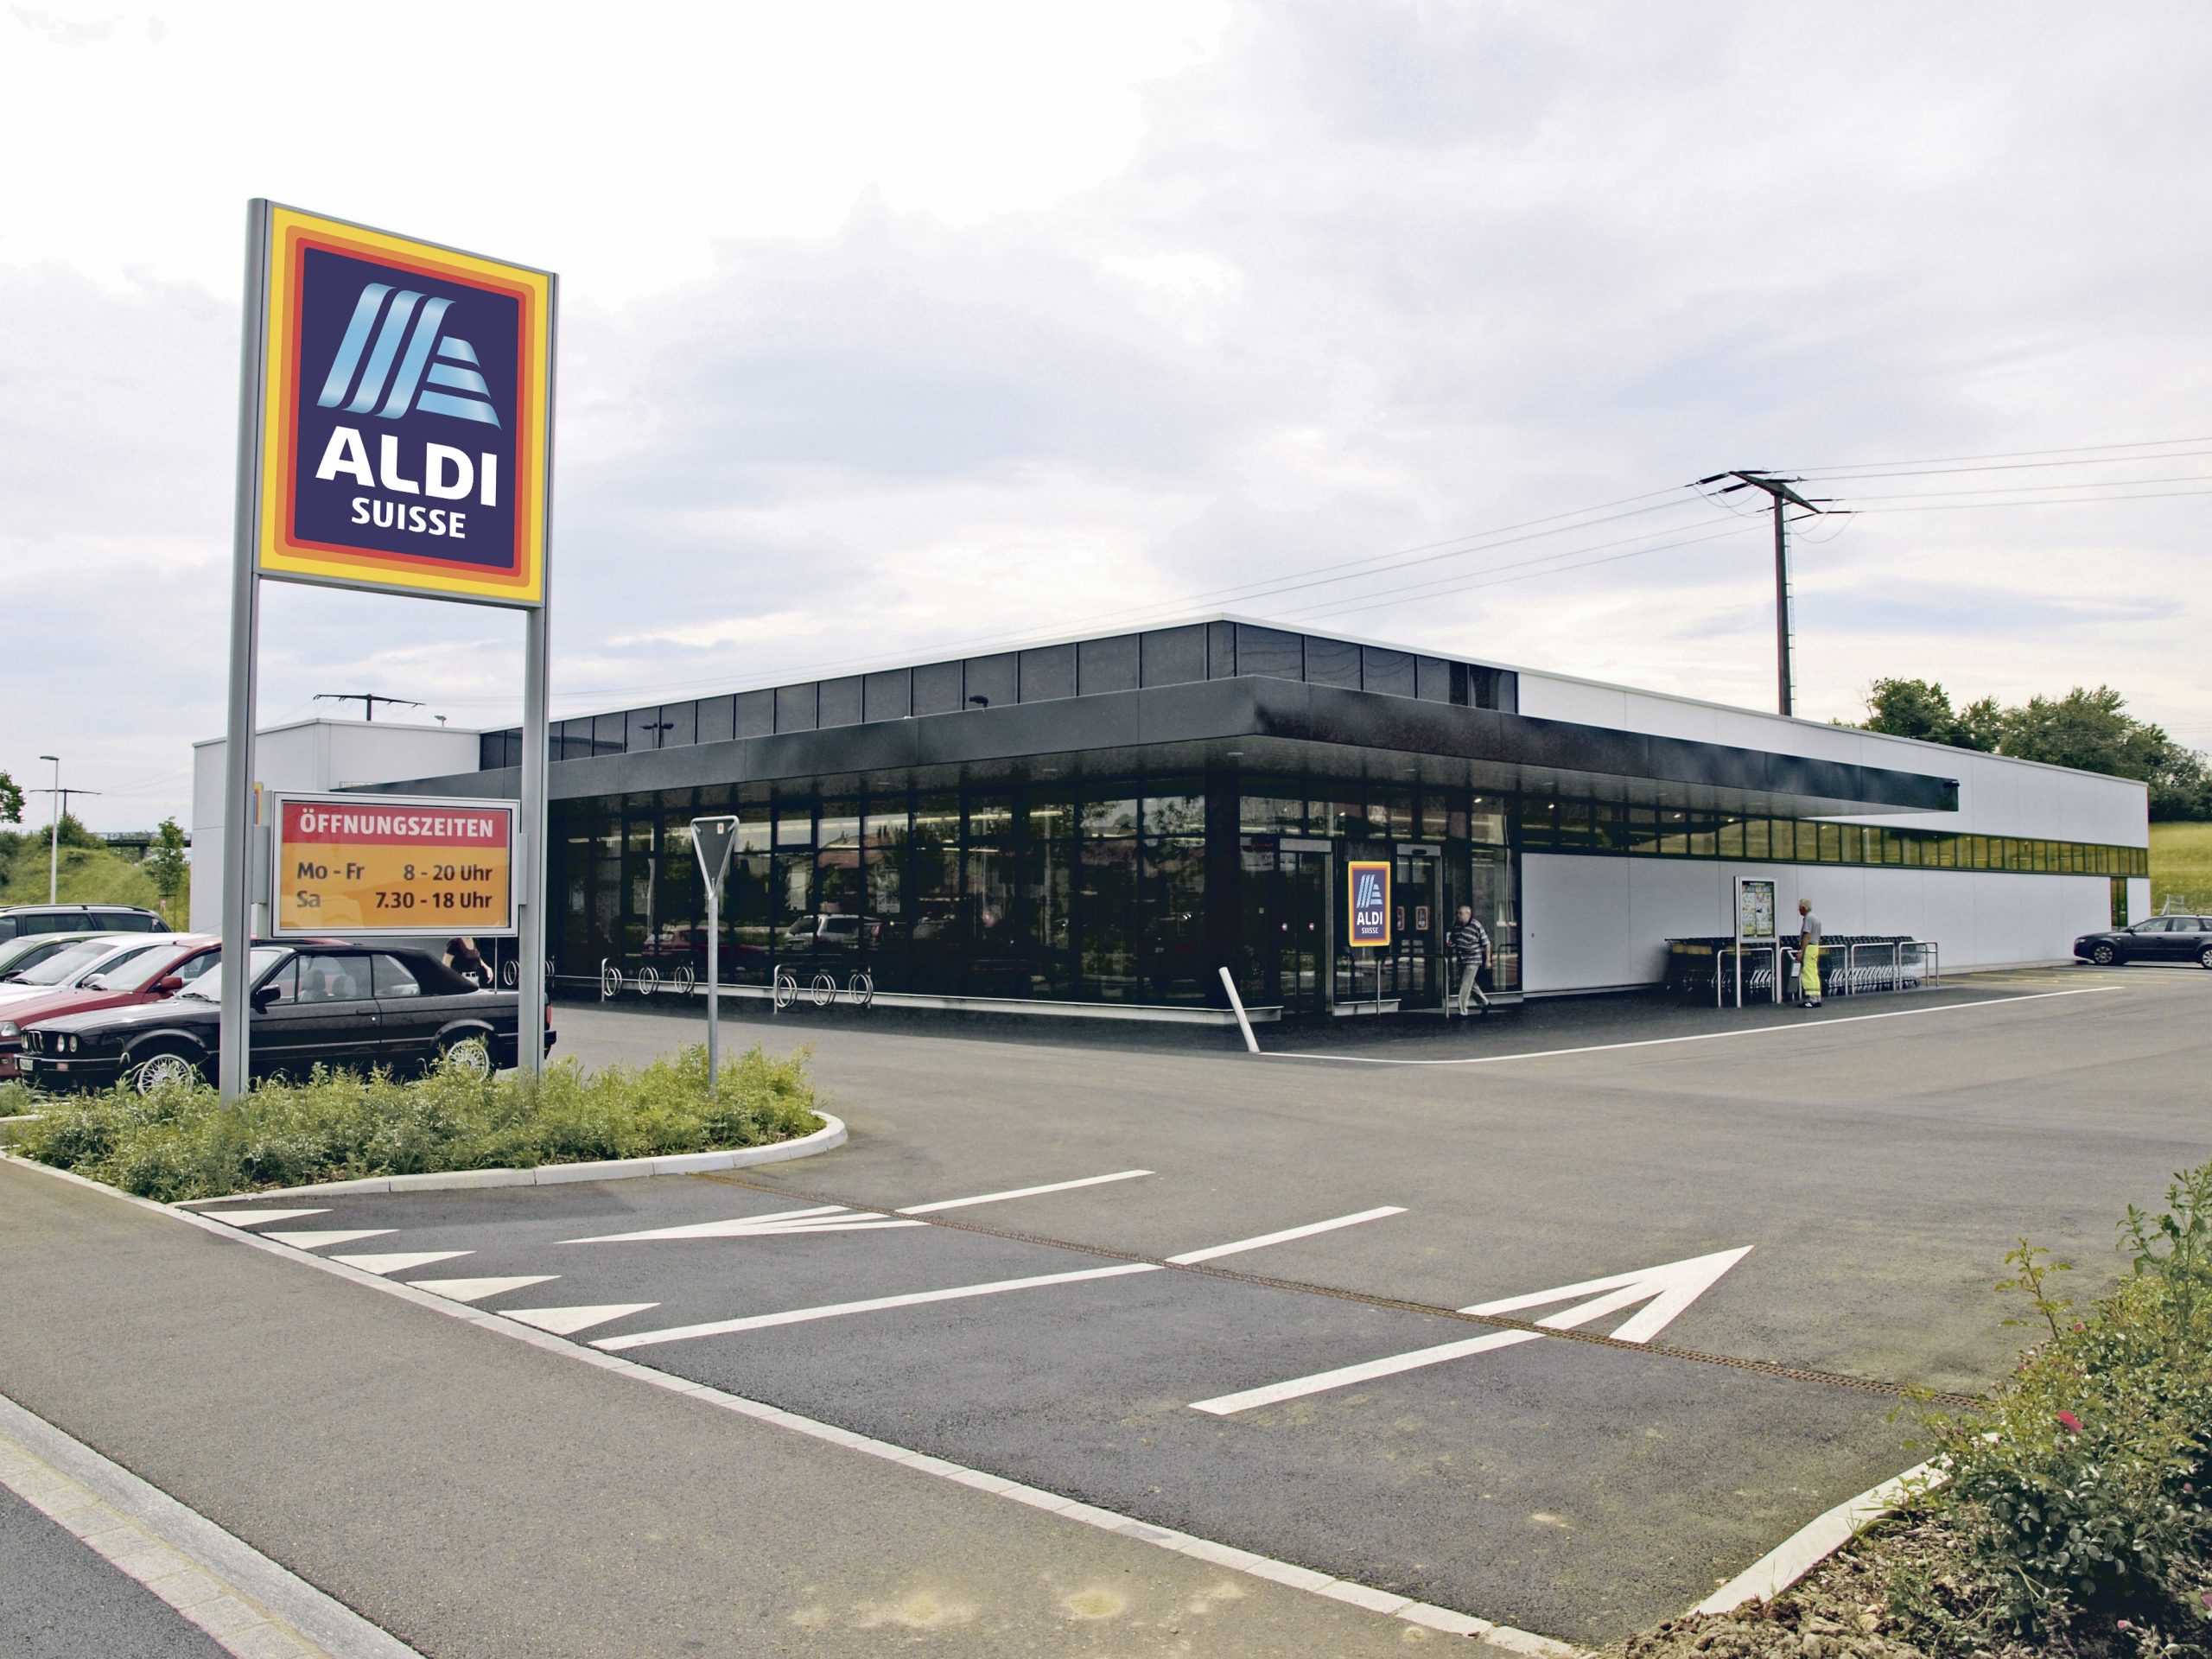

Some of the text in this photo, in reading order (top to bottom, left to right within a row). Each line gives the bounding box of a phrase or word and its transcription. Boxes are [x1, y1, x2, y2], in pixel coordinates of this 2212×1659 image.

[315, 425, 498, 507] ALDI
[351, 497, 467, 539] SUISSE
[300, 807, 493, 837] ÖFFNUNGSZEITEN
[296, 861, 328, 880] Mo
[346, 862, 365, 880] Fr
[433, 864, 455, 880] 20
[461, 863, 493, 881] Uhr
[296, 890, 321, 908] Sa
[375, 891, 415, 908] 7.30
[432, 892, 454, 908] 18
[460, 891, 493, 908] Uhr
[1357, 911, 1382, 925] ALDI
